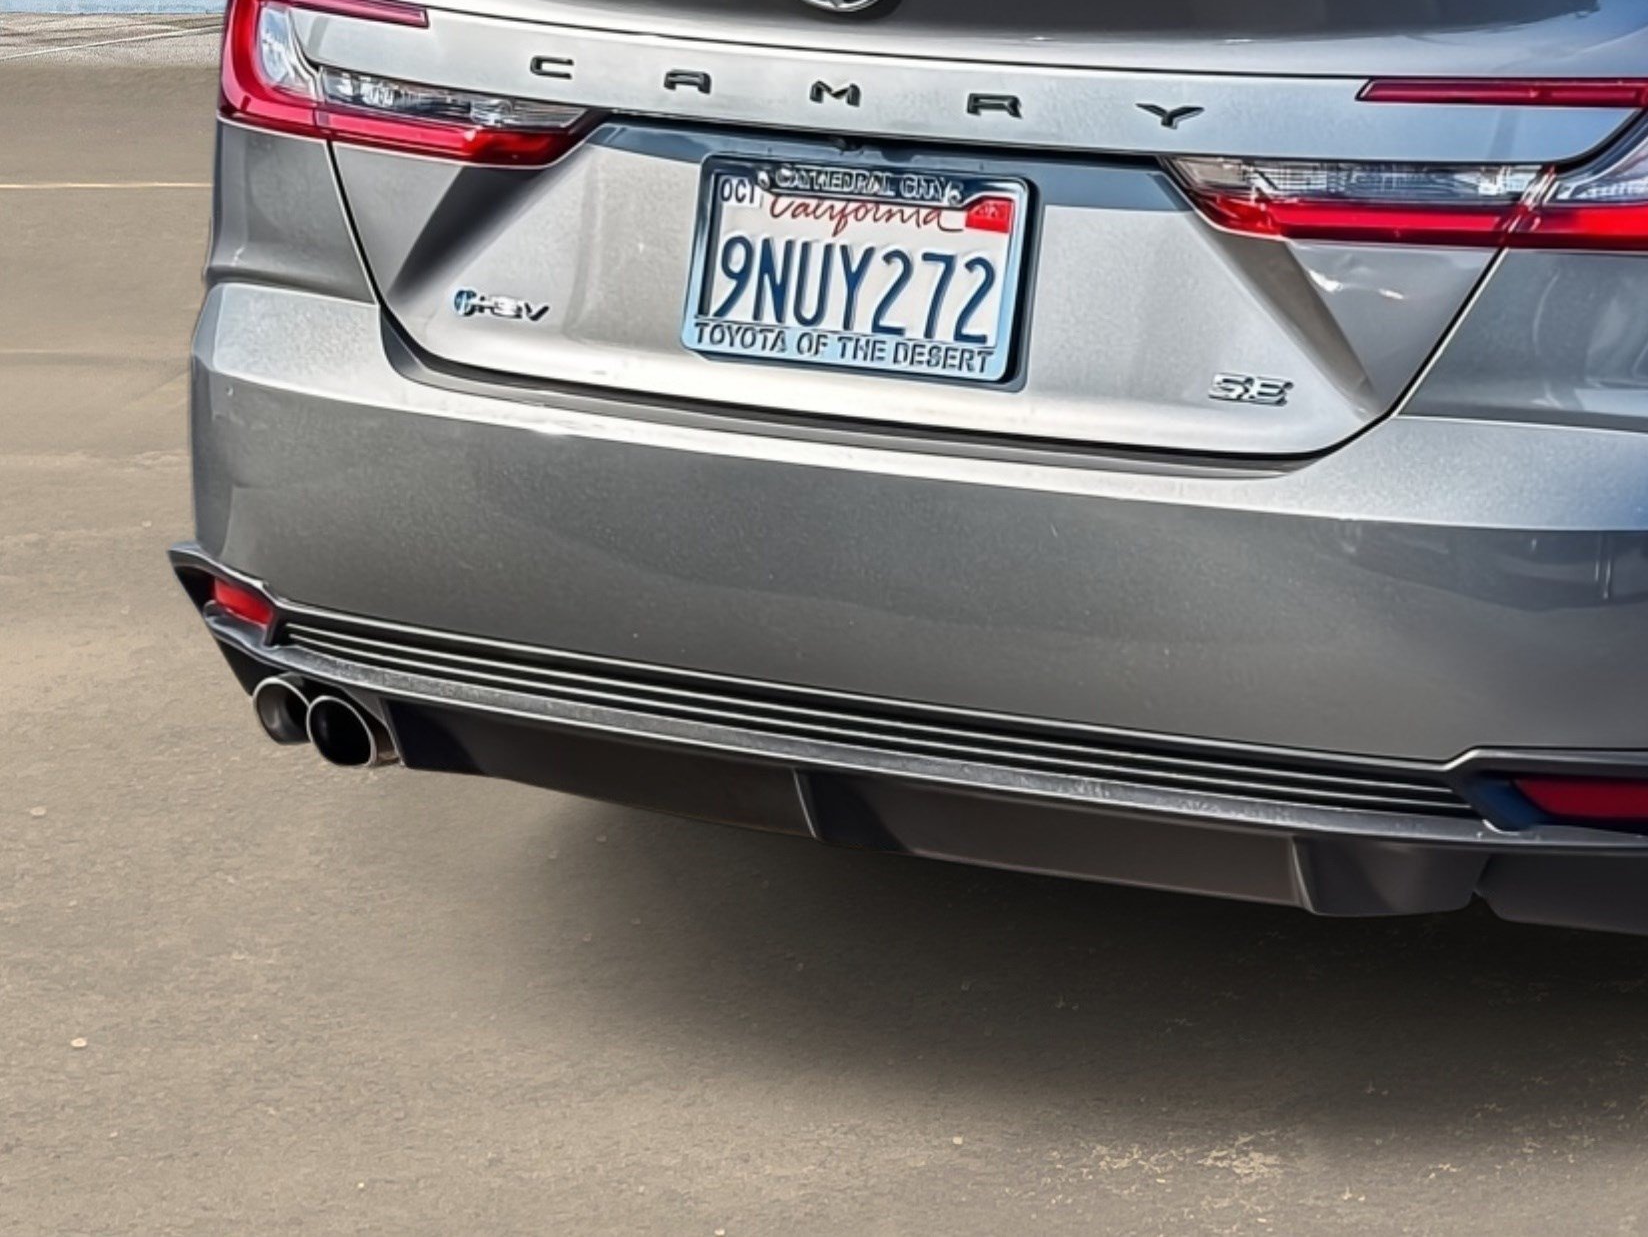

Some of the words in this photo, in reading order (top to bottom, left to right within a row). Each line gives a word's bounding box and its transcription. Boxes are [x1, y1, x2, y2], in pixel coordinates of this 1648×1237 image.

[529, 54, 1205, 130] CAMRY
[720, 177, 757, 204] OCT
[775, 162, 897, 197] CATHEDRAL
[899, 173, 950, 204] CITY
[711, 235, 997, 344] 9NUY272
[693, 321, 788, 354] TOYOTA
[796, 331, 830, 357] OF
[837, 337, 887, 363] THE
[892, 341, 995, 374] DESERT
